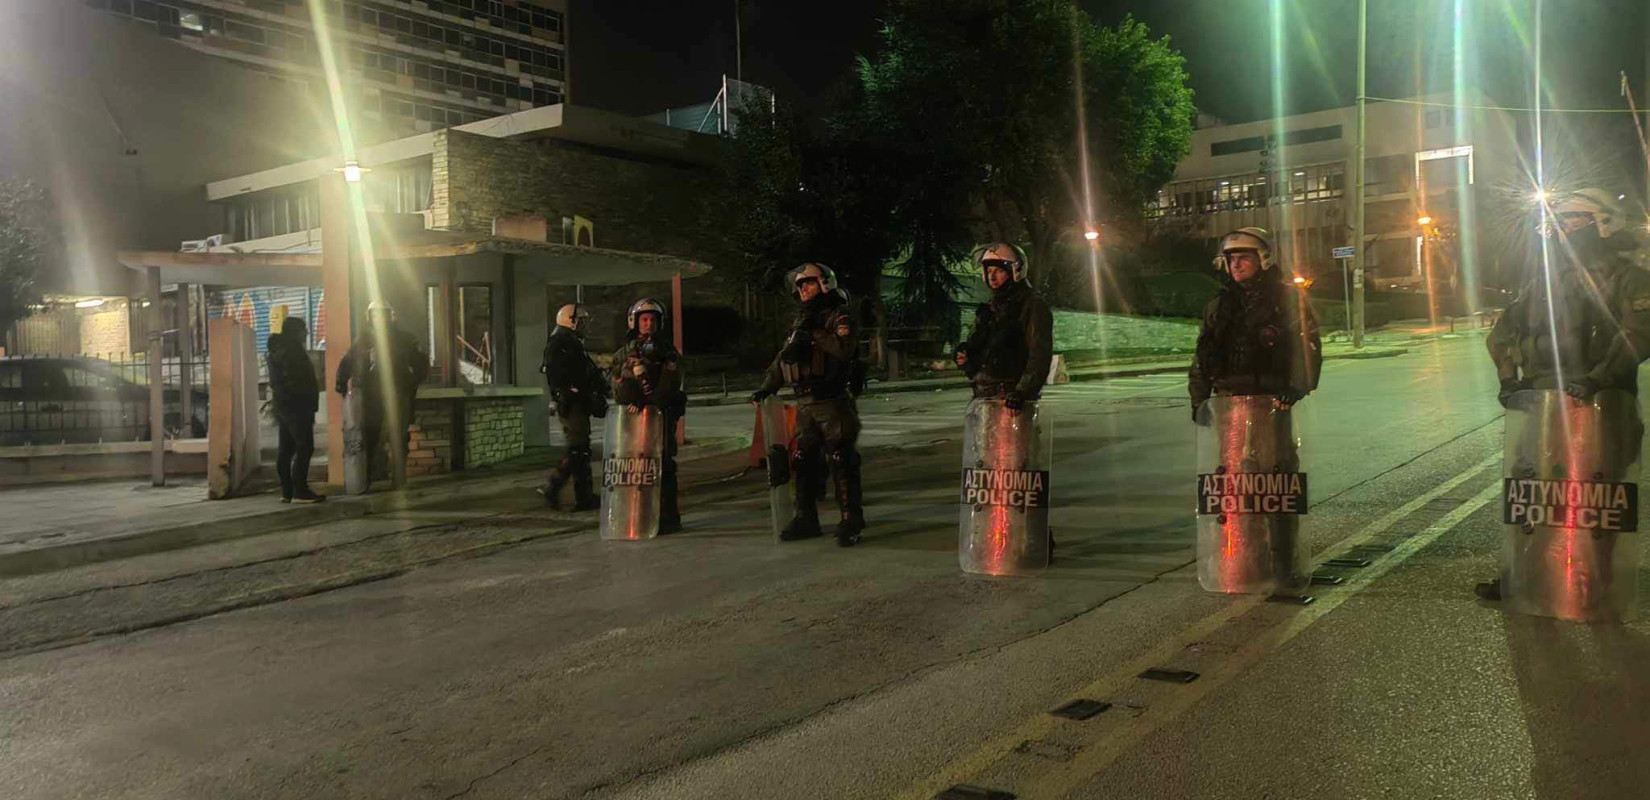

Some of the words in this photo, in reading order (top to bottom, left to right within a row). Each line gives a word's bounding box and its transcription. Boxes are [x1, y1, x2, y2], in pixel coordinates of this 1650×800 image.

[604, 472, 654, 486] POLICE
[965, 469, 1043, 491] ΑΣΤΥΝΟΜΙΑ
[1202, 473, 1302, 496] ΑΣΤΥΝΟΜΙΑ
[966, 488, 1038, 507] POLICE
[1206, 495, 1297, 513] POLICE
[1507, 479, 1628, 509] ΑΣΤΥΝΟΜΙΑ
[1511, 504, 1621, 530] POLICE
